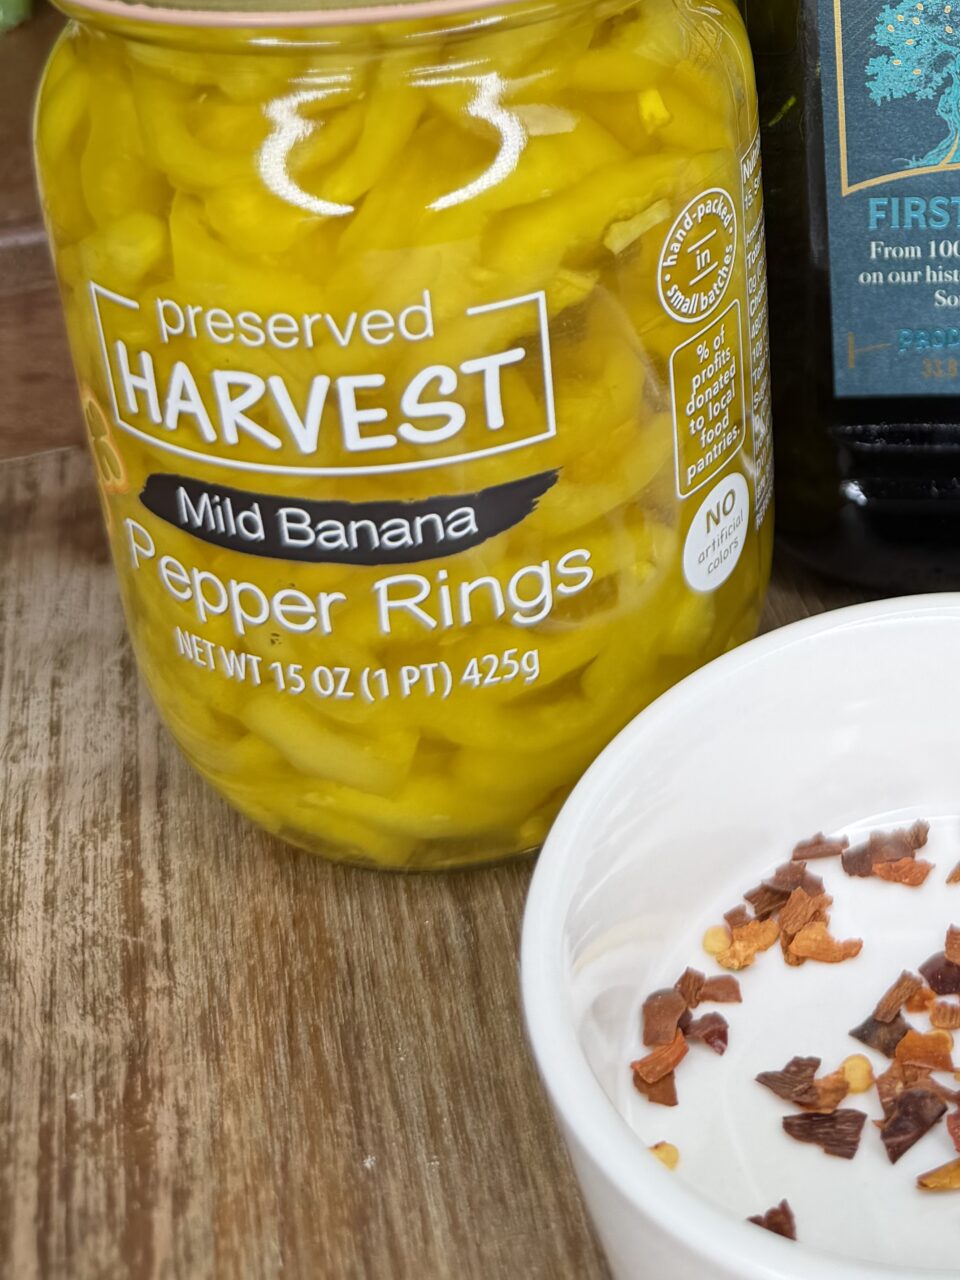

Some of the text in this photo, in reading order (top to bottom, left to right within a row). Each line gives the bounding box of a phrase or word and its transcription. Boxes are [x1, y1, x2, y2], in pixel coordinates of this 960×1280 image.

[662, 195, 733, 267] hand-packed
[869, 240, 922, 261] From
[667, 284, 699, 314] small
[700, 244, 733, 311] batches
[695, 249, 710, 271] in
[858, 270, 884, 285] on
[887, 270, 922, 284] our
[156, 289, 435, 347] preserved
[713, 324, 725, 346] of
[115, 339, 526, 455] HARVEST
[685, 356, 736, 416] donated
[692, 347, 730, 396] profits
[689, 415, 705, 435] to
[708, 379, 735, 422] local
[701, 407, 729, 448] food
[687, 425, 740, 485] pantries.
[175, 486, 479, 551] Mild Banana
[698, 507, 744, 564] artificial
[706, 488, 736, 534] NO
[124, 517, 594, 635] Pepper Rings
[707, 537, 739, 574] colors
[175, 626, 541, 703] NET WT 15 OZ (1 PT) 425g
